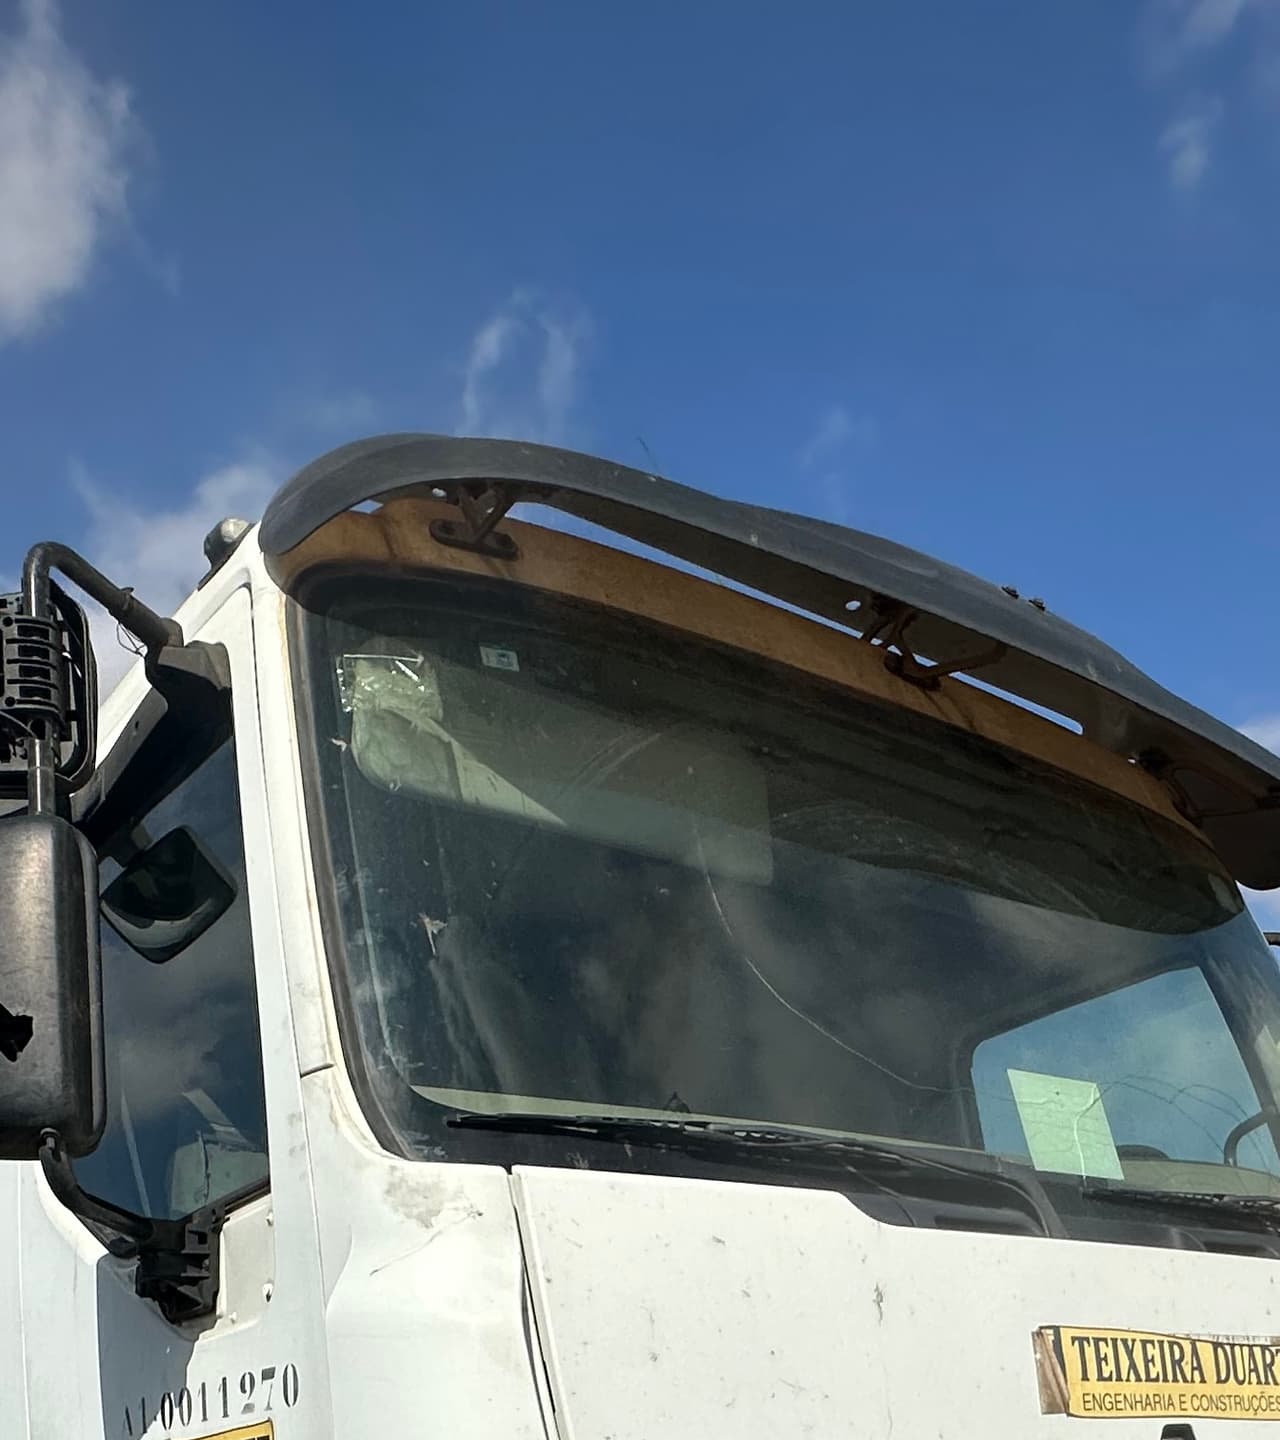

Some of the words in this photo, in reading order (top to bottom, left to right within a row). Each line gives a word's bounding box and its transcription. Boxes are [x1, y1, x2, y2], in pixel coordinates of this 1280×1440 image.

[1071, 1336, 1206, 1384] TEIXEIRA
[1083, 1391, 1176, 1412] ENGENHARIA
[1179, 1394, 1187, 1411] E
